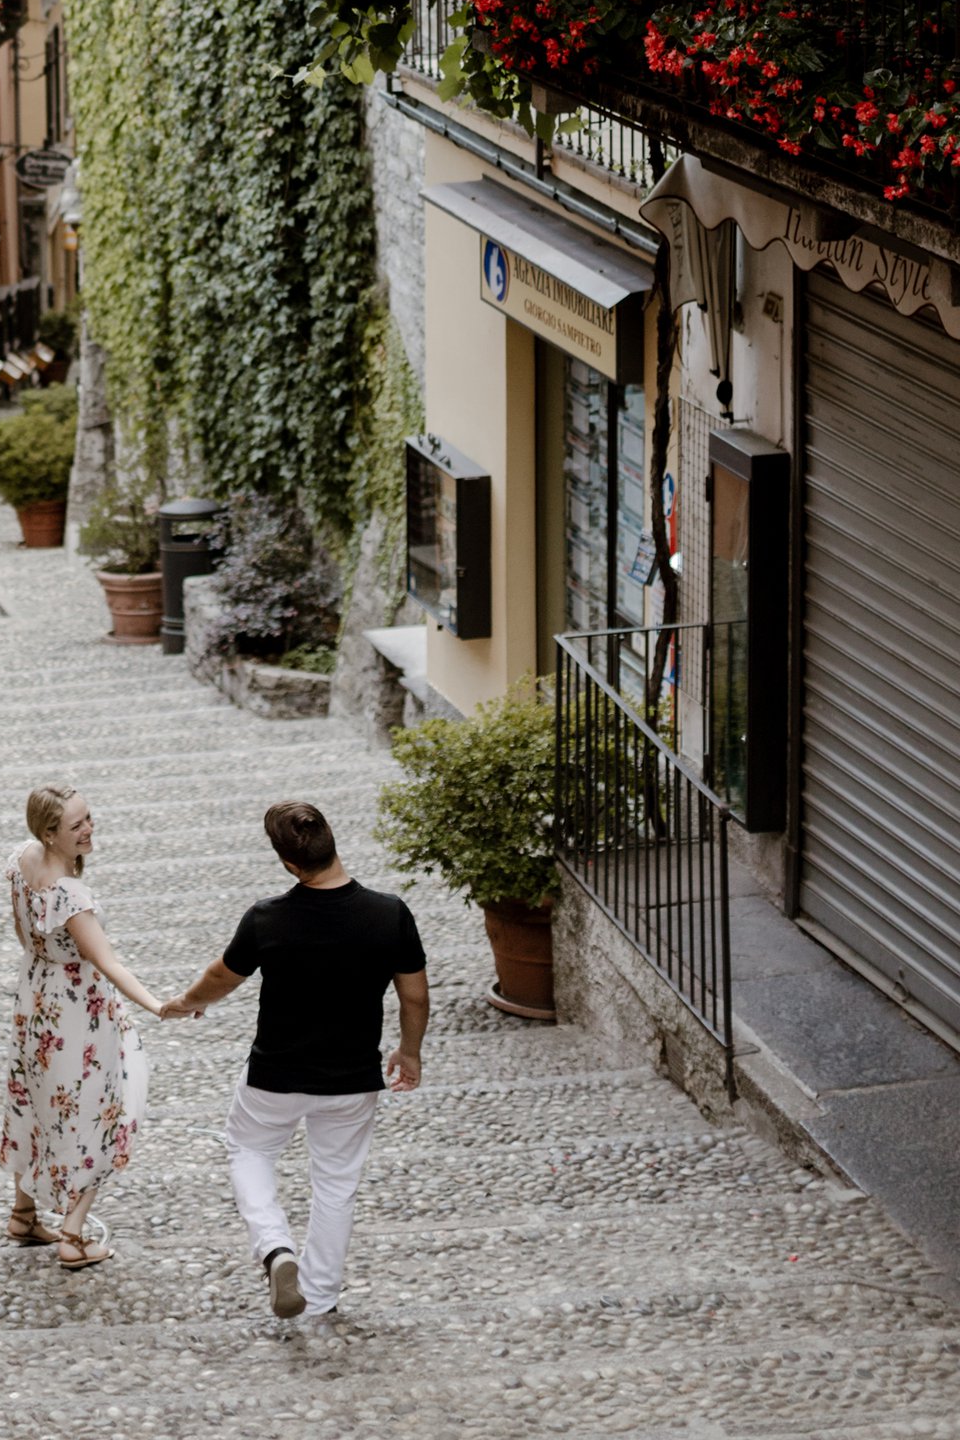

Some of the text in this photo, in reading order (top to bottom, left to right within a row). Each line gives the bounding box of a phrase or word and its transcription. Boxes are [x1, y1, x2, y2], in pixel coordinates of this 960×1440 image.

[513, 255, 615, 336] AGENZIA IMMOBILIARE
[872, 246, 931, 306] Style
[524, 298, 602, 358] GIORGIO SAMPIETRO
